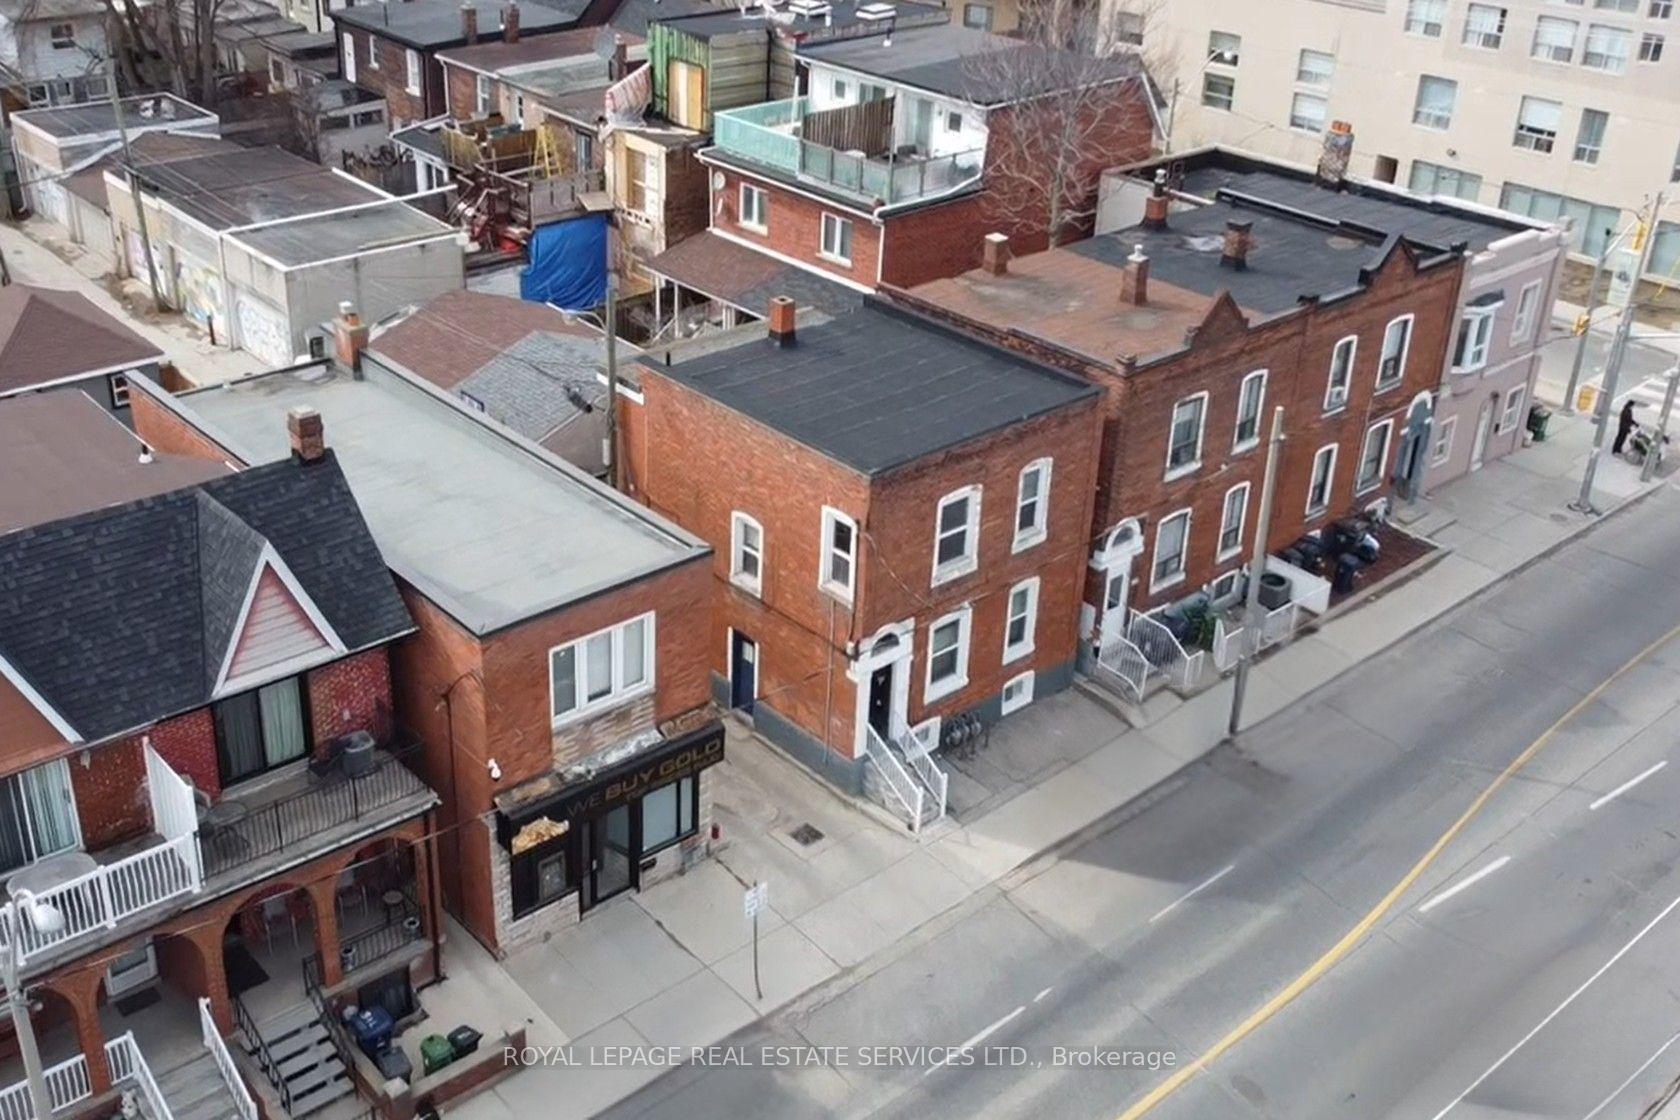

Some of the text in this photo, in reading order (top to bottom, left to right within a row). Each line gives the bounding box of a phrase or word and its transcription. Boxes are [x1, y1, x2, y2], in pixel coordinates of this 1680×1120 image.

[567, 795, 601, 816] WE
[604, 767, 656, 801] BUY
[659, 738, 722, 776] GOLD
